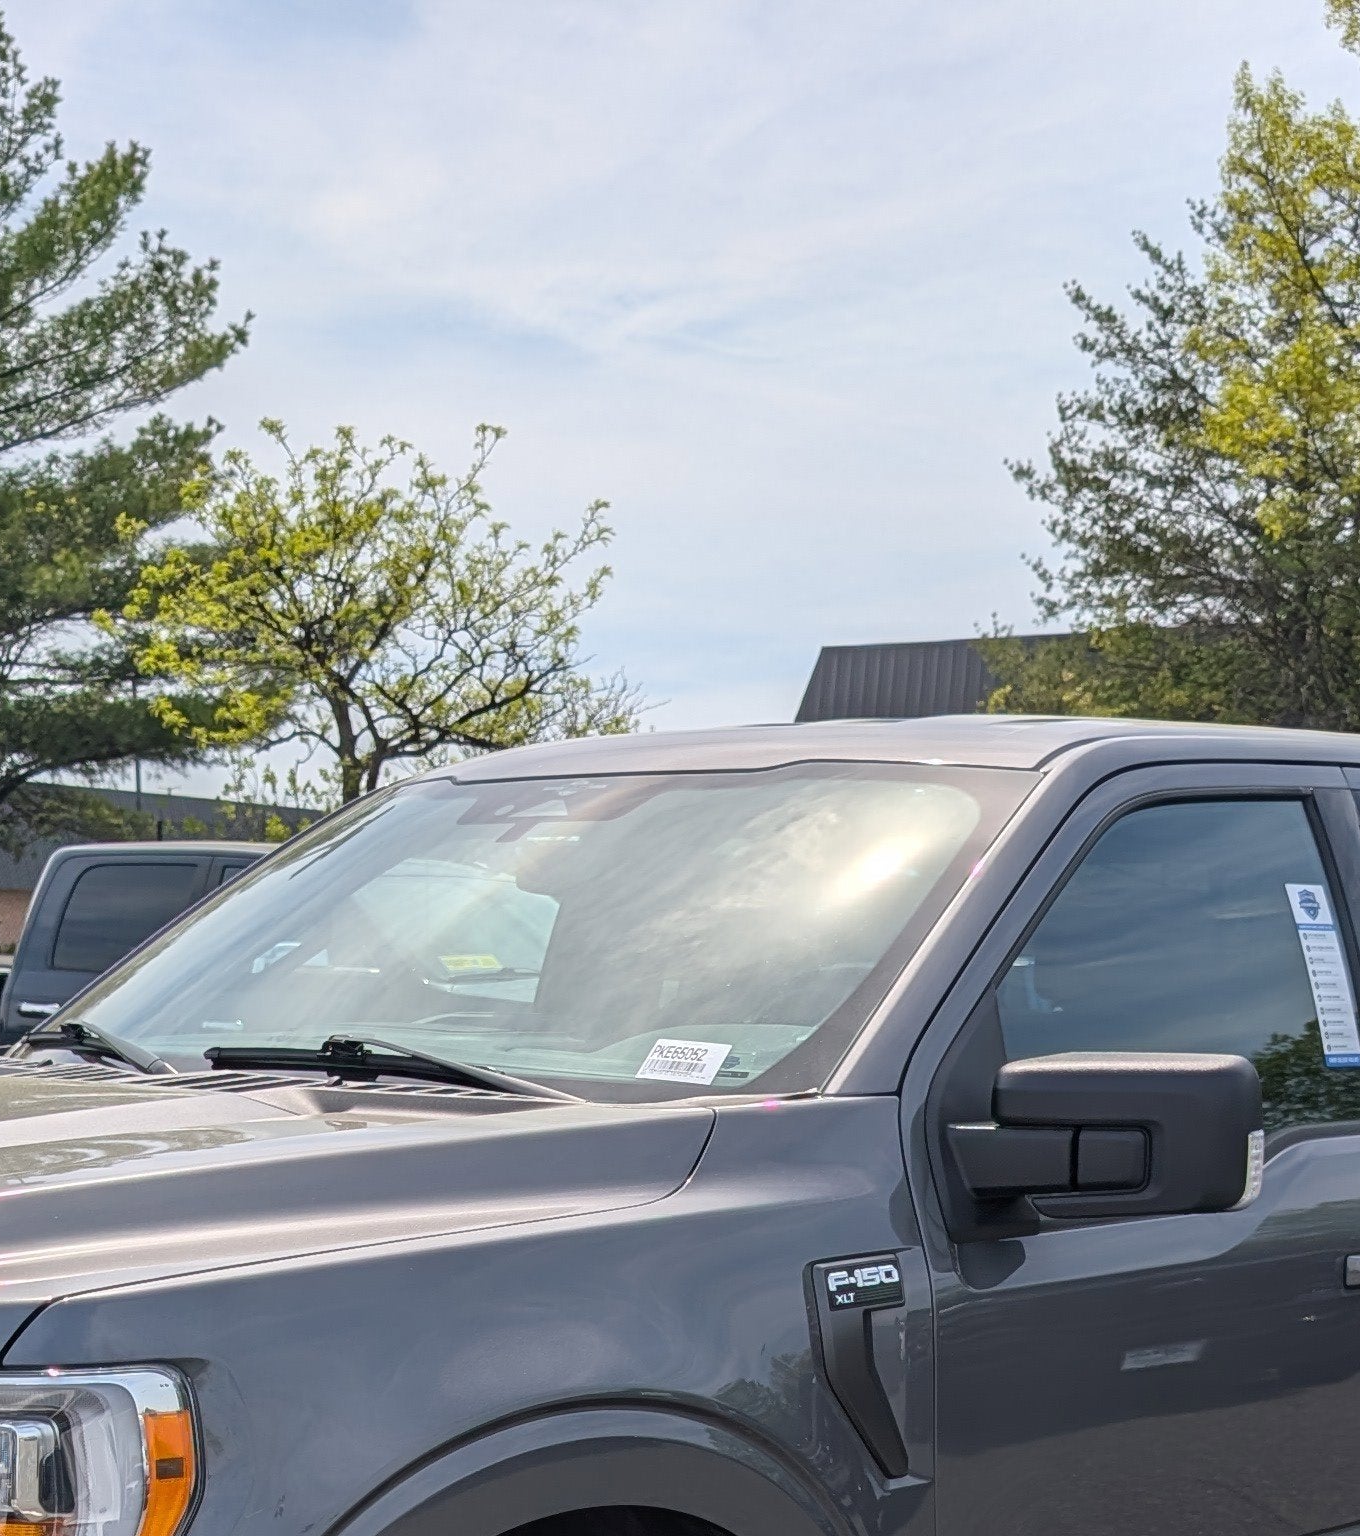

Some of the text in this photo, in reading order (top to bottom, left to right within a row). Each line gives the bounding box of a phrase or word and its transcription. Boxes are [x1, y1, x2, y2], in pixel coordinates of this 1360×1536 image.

[651, 1044, 708, 1062] PKE65052
[827, 1264, 899, 1291] F-150
[835, 1292, 855, 1305] XLT
